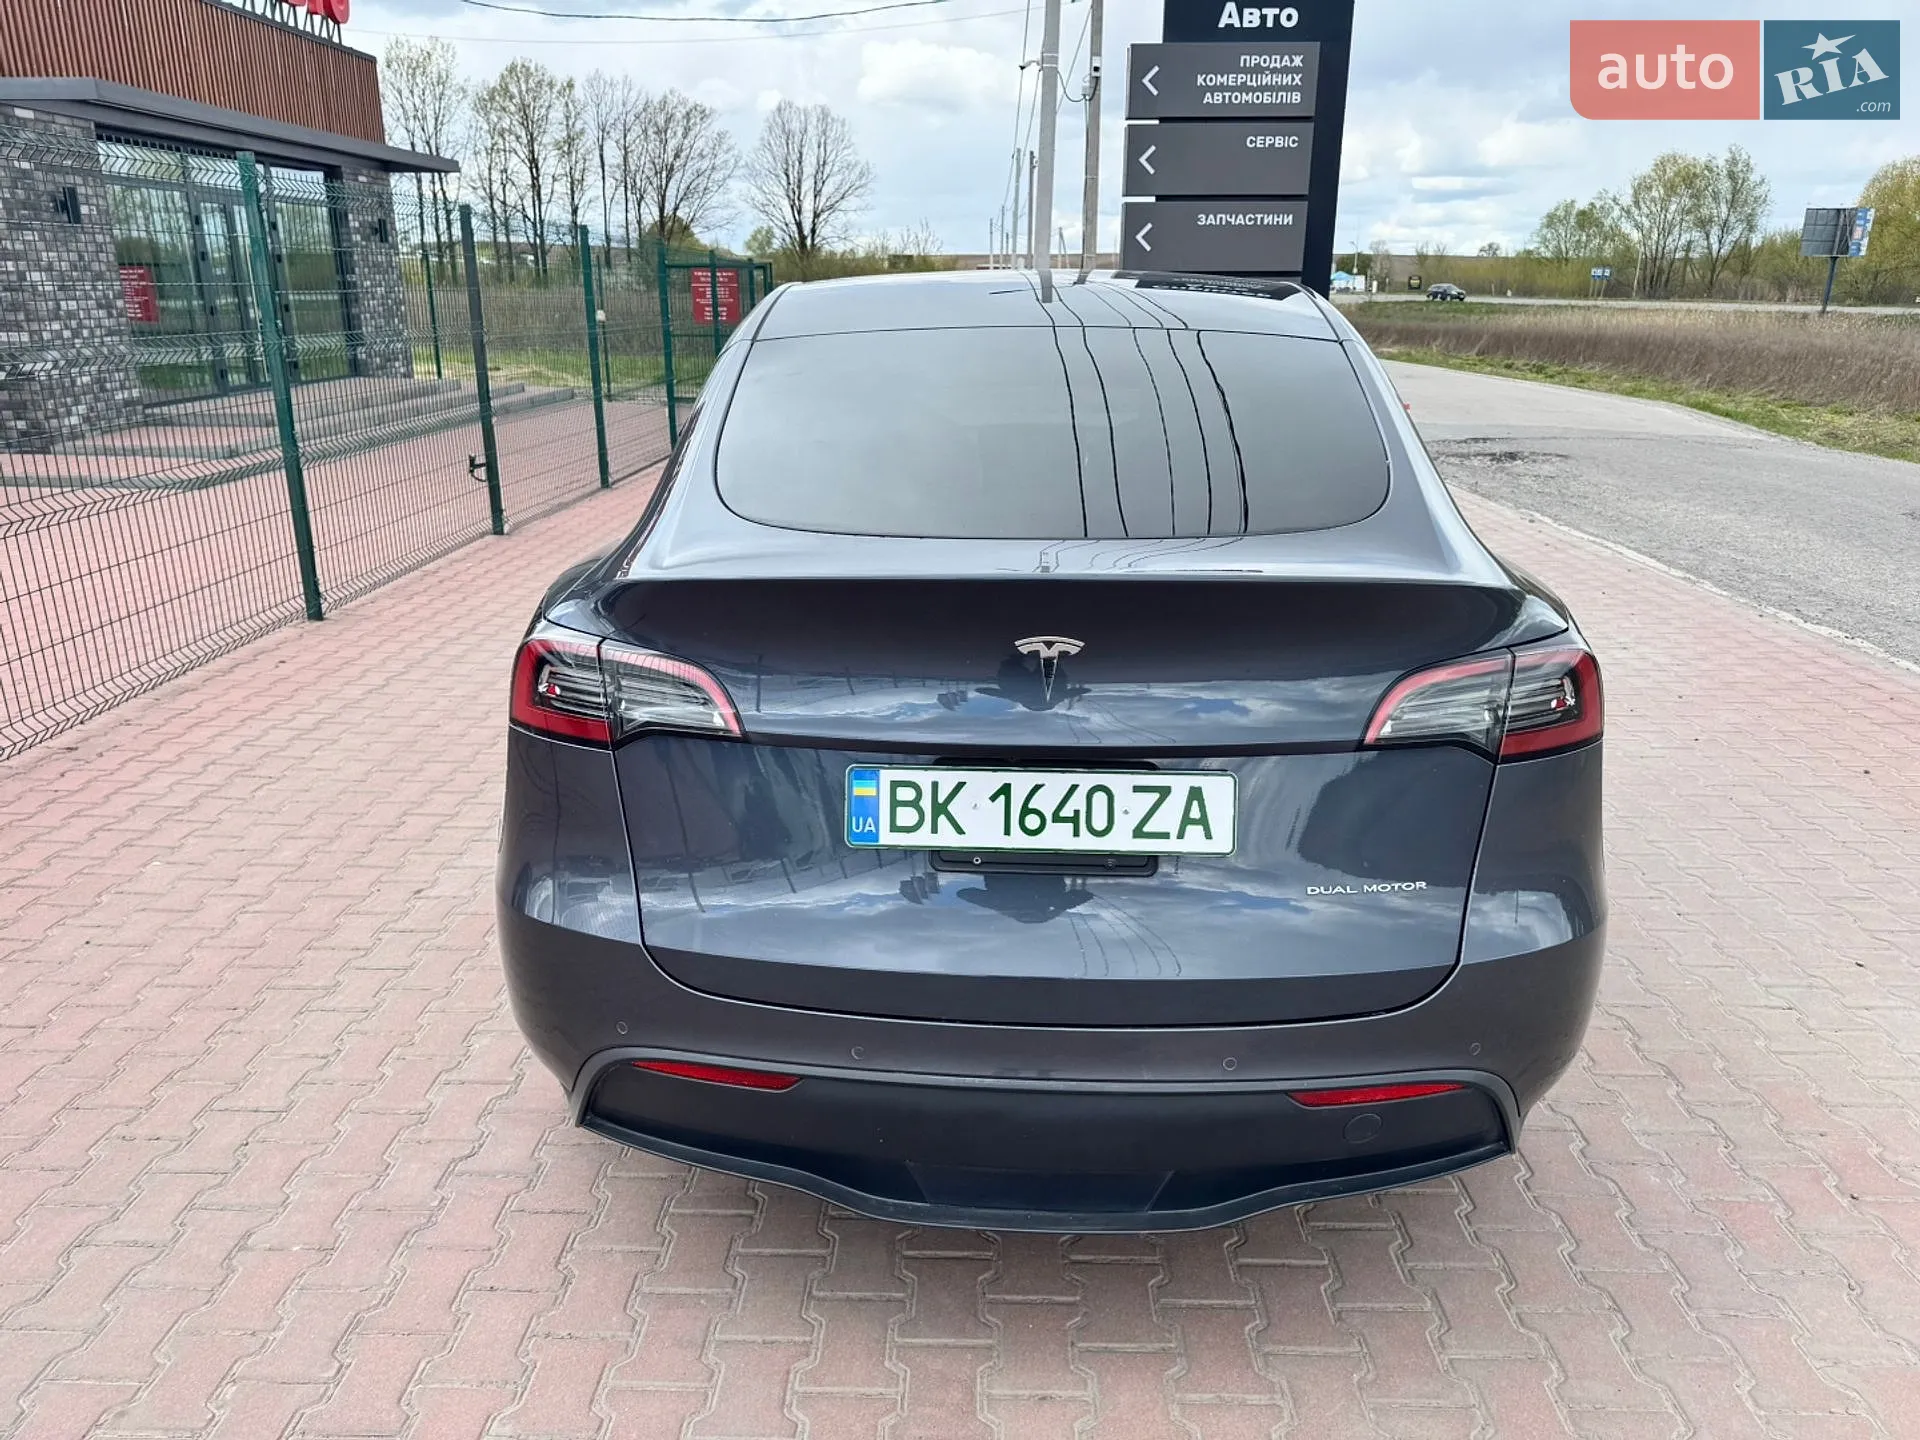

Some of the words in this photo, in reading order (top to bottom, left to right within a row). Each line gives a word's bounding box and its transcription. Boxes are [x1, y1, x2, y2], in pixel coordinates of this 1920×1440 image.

[1218, 1, 1299, 28] Авто
[1240, 54, 1303, 68] ПРОДАЖ
[1197, 70, 1302, 87] КОМЕРЦІЙНИХ
[1203, 91, 1301, 104] АВТОМОБІЛІВ
[1246, 136, 1299, 148] СЕРВІС
[1197, 213, 1293, 225] ЗАПЧАСТИНИ
[889, 780, 967, 835] BK
[989, 782, 1115, 838] 1640
[1132, 785, 1214, 840] ZA
[852, 816, 876, 833] UA
[1306, 885, 1358, 895] DUAL
[1363, 881, 1427, 893] MOTOR
